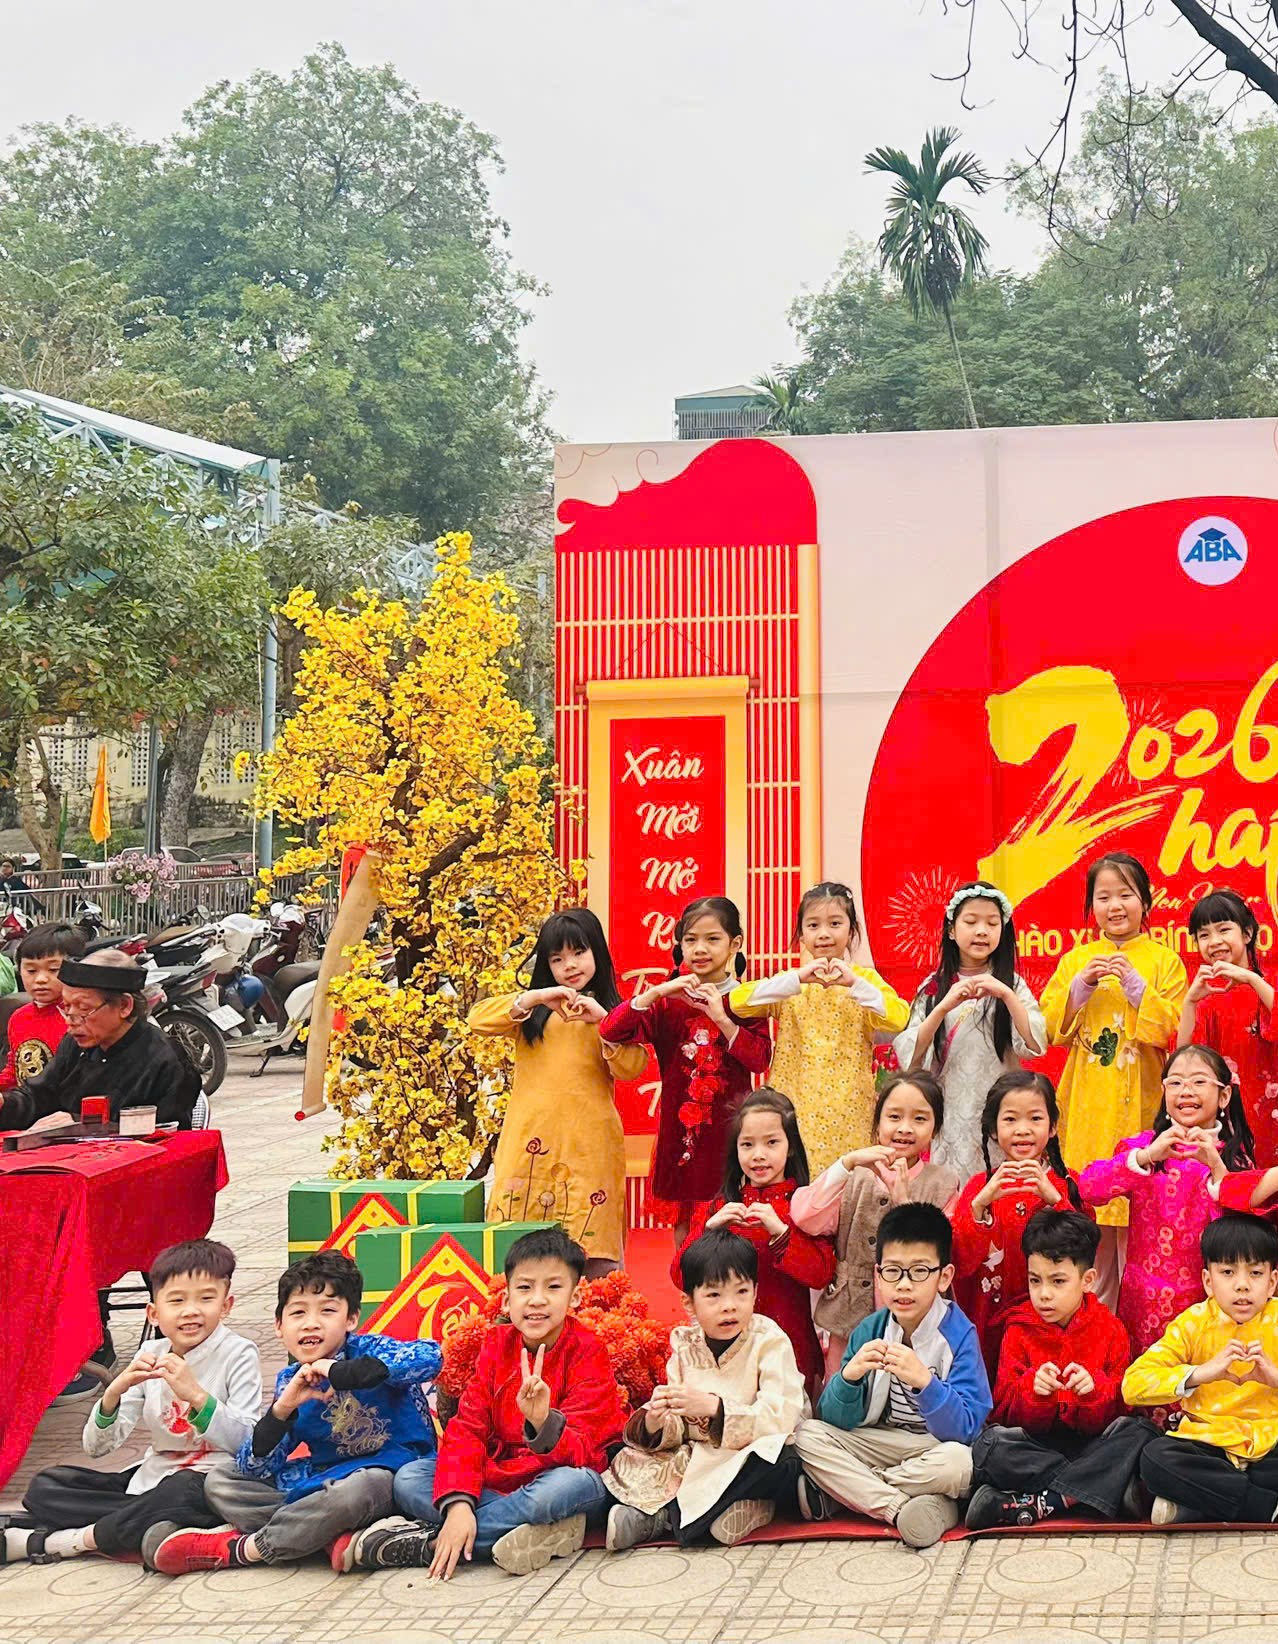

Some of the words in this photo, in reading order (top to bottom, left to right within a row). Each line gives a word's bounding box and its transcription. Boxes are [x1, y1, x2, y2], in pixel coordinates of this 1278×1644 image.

[1183, 538, 1243, 563] ABA
[620, 746, 705, 788] Xuân
[635, 801, 703, 841] Mới
[639, 857, 700, 896] Mở
[1015, 923, 1063, 957] HÀO
[1149, 919, 1199, 953] BÍN
